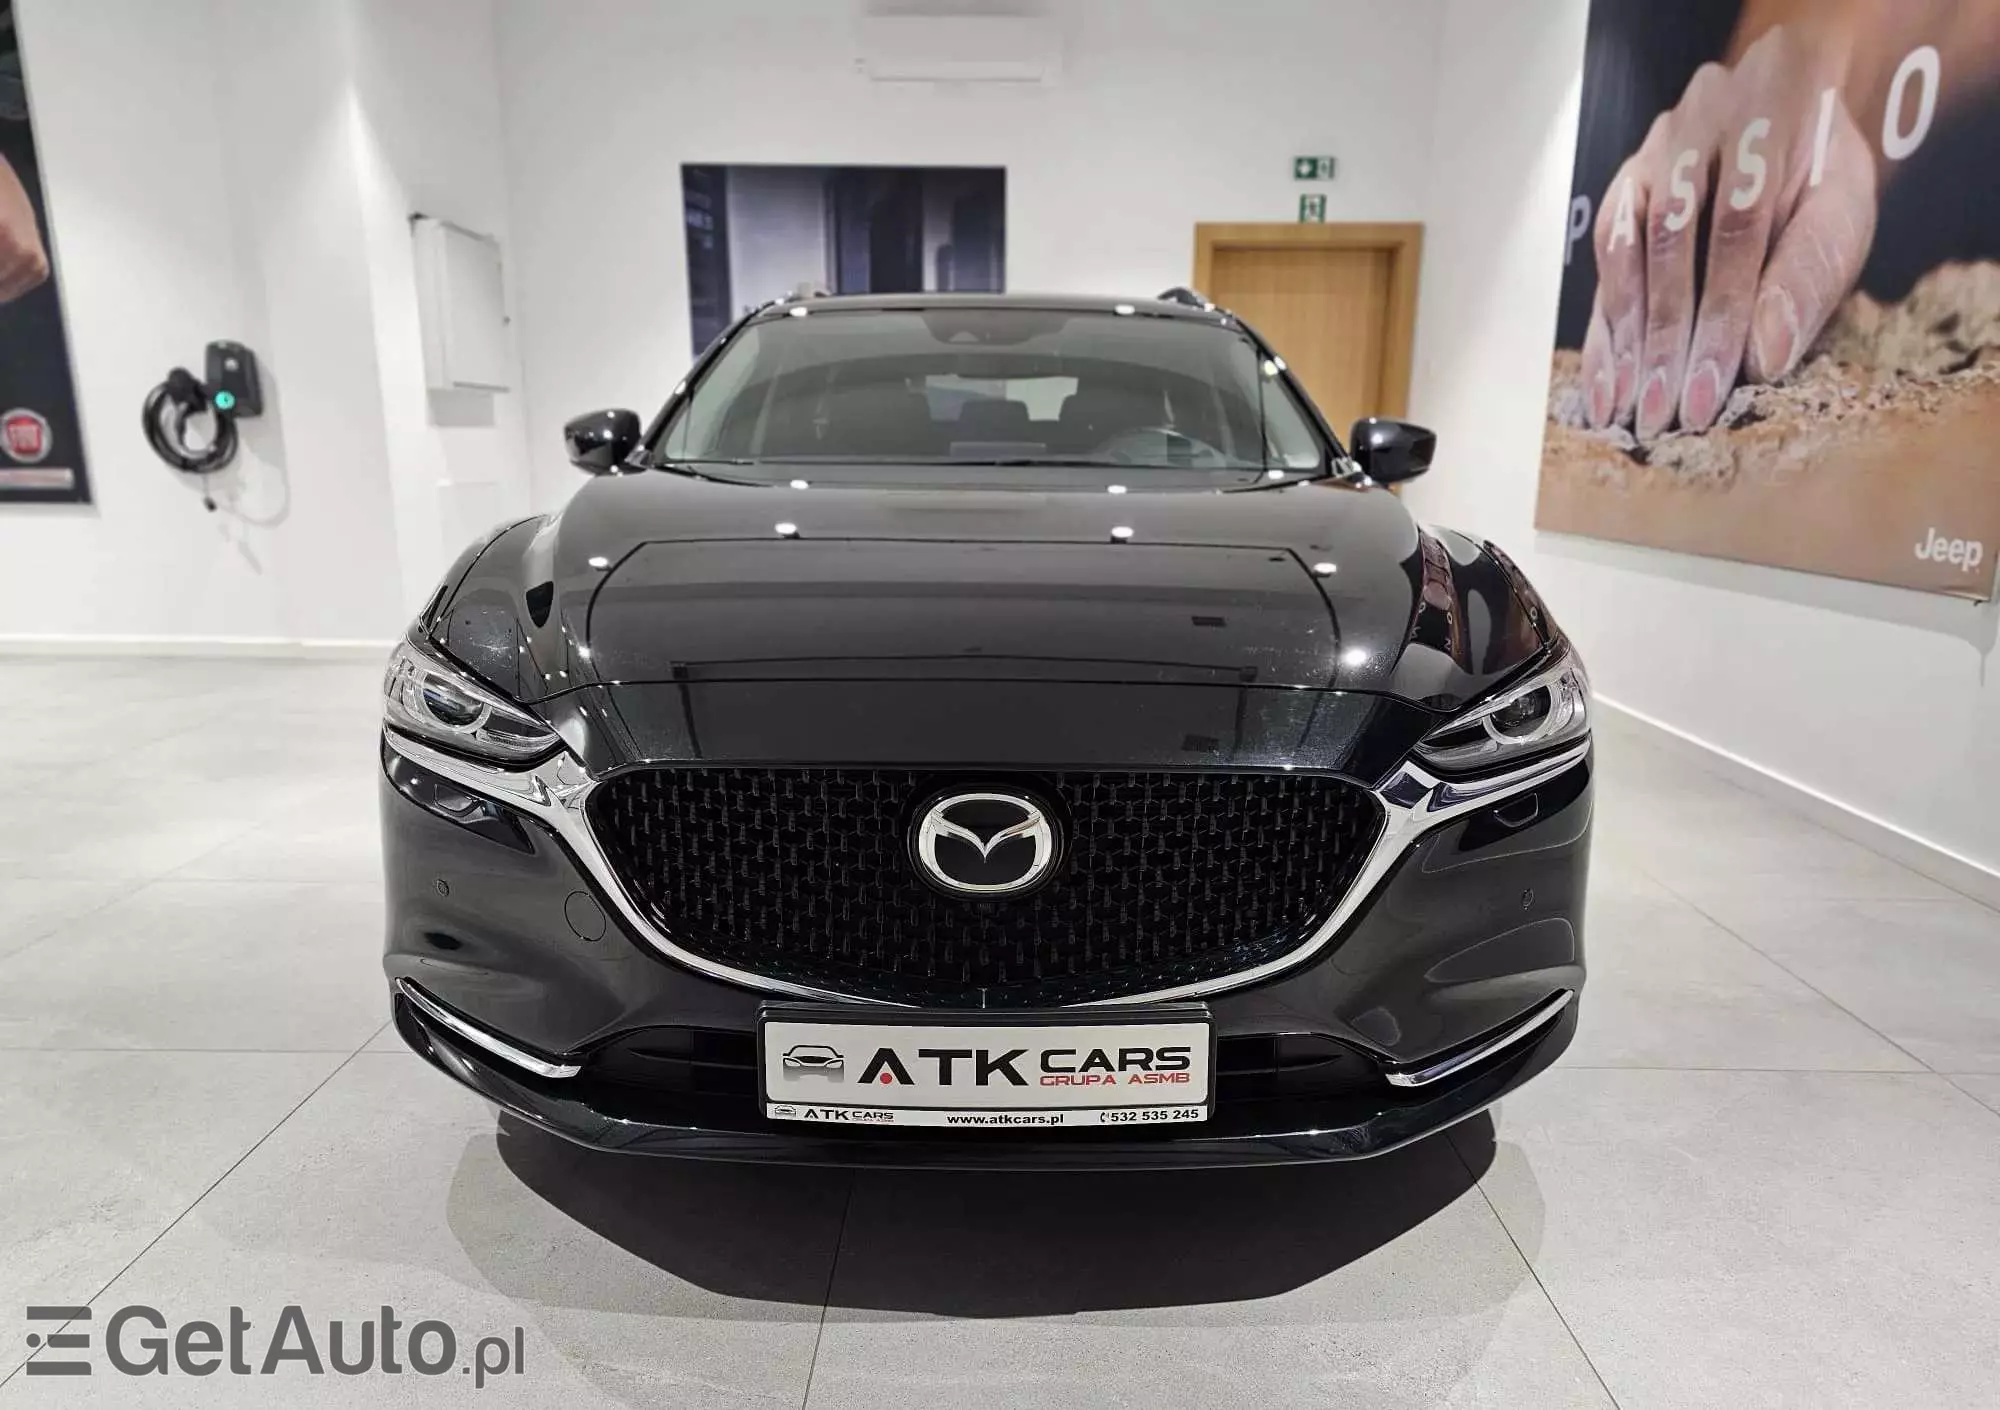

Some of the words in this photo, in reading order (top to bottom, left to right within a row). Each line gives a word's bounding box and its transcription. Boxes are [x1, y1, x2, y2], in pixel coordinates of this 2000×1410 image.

[1914, 527, 1983, 572] Jeep
[857, 1047, 1029, 1086] ATK
[1040, 1047, 1191, 1073] CARS
[1040, 1074, 1117, 1086] GRUPA
[1128, 1073, 1190, 1084] ASMB
[804, 1109, 849, 1120] ATK
[852, 1111, 894, 1119] CARS
[947, 1114, 1063, 1125] www.atkcars.pl
[1111, 1112, 1137, 1121] 532
[1142, 1110, 1168, 1120] 535
[1173, 1109, 1199, 1119] 245
